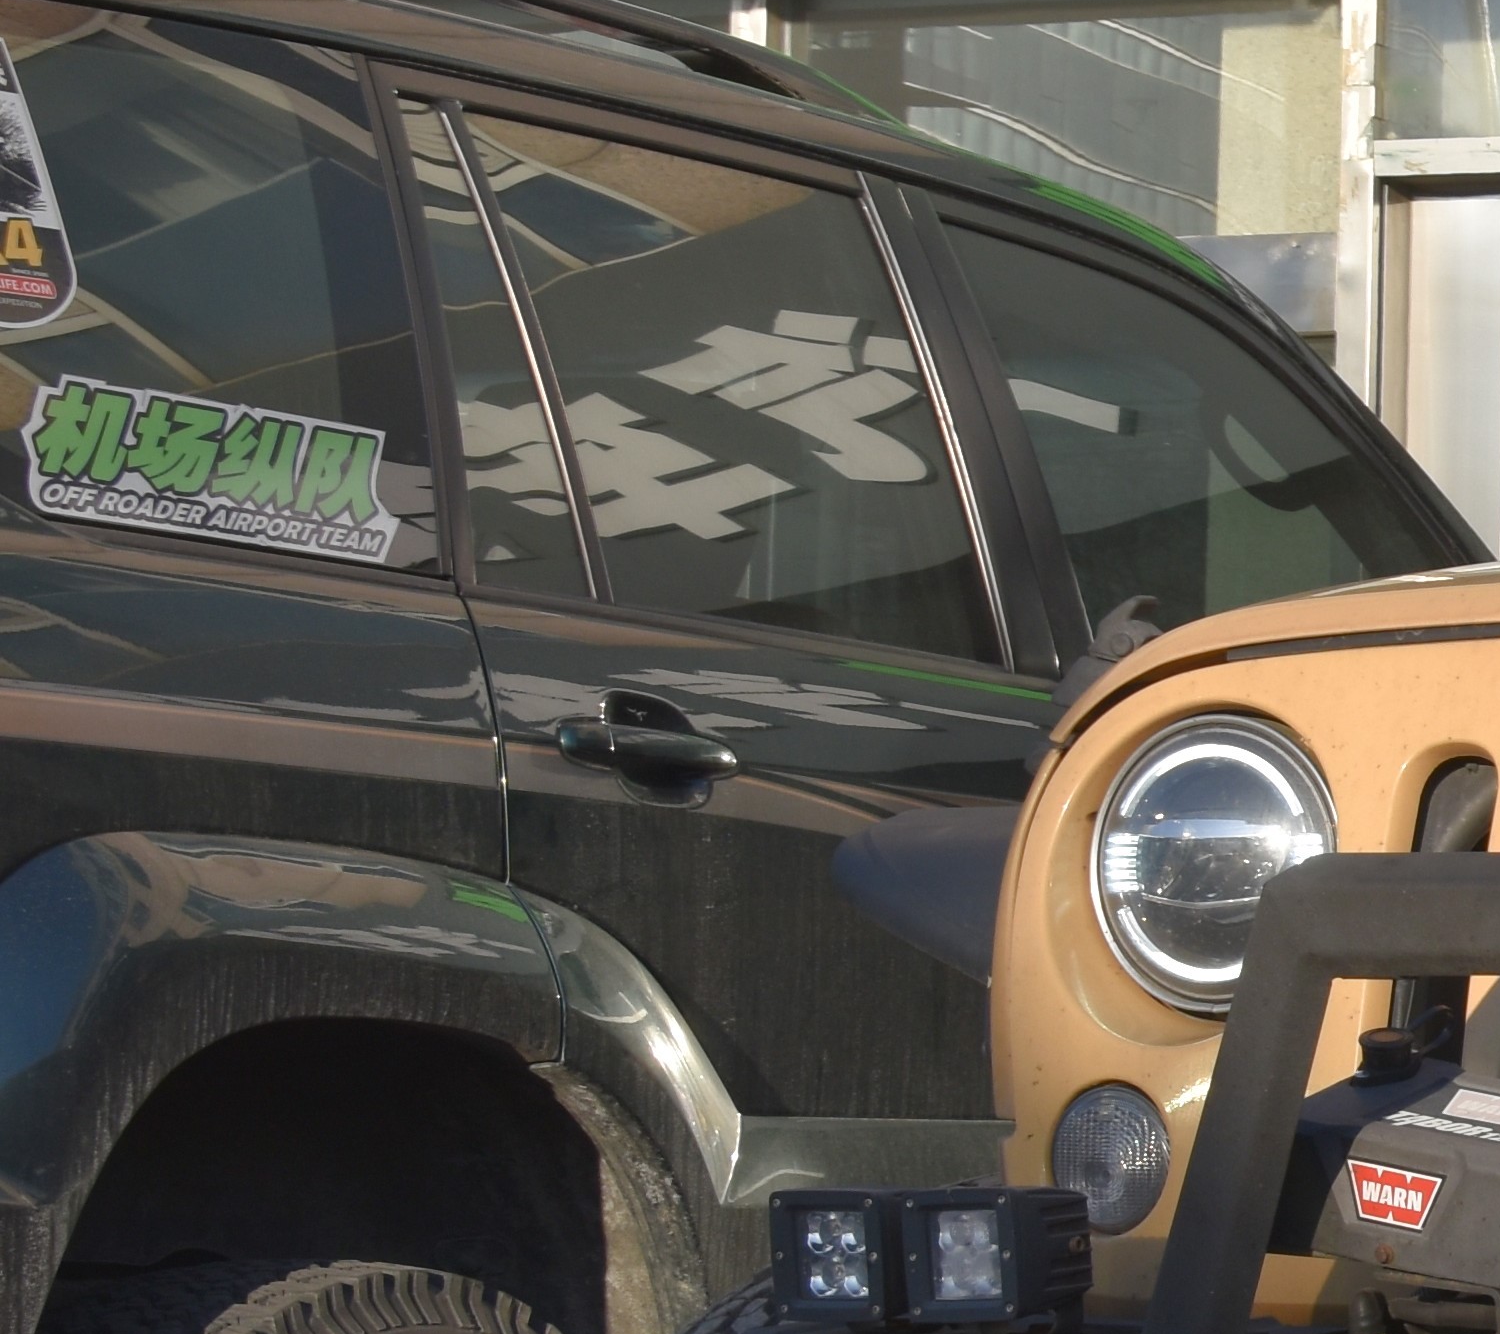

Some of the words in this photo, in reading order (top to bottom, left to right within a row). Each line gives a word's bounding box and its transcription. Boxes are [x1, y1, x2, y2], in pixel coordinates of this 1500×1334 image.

[0, 277, 53, 296] IFE.COM
[35, 383, 378, 523] 机场纵队
[43, 483, 99, 507] OFF
[101, 493, 207, 525] ROADER
[210, 511, 318, 542] AIRPORT
[319, 525, 385, 552] TEAM
[1361, 1179, 1423, 1213] WARN
